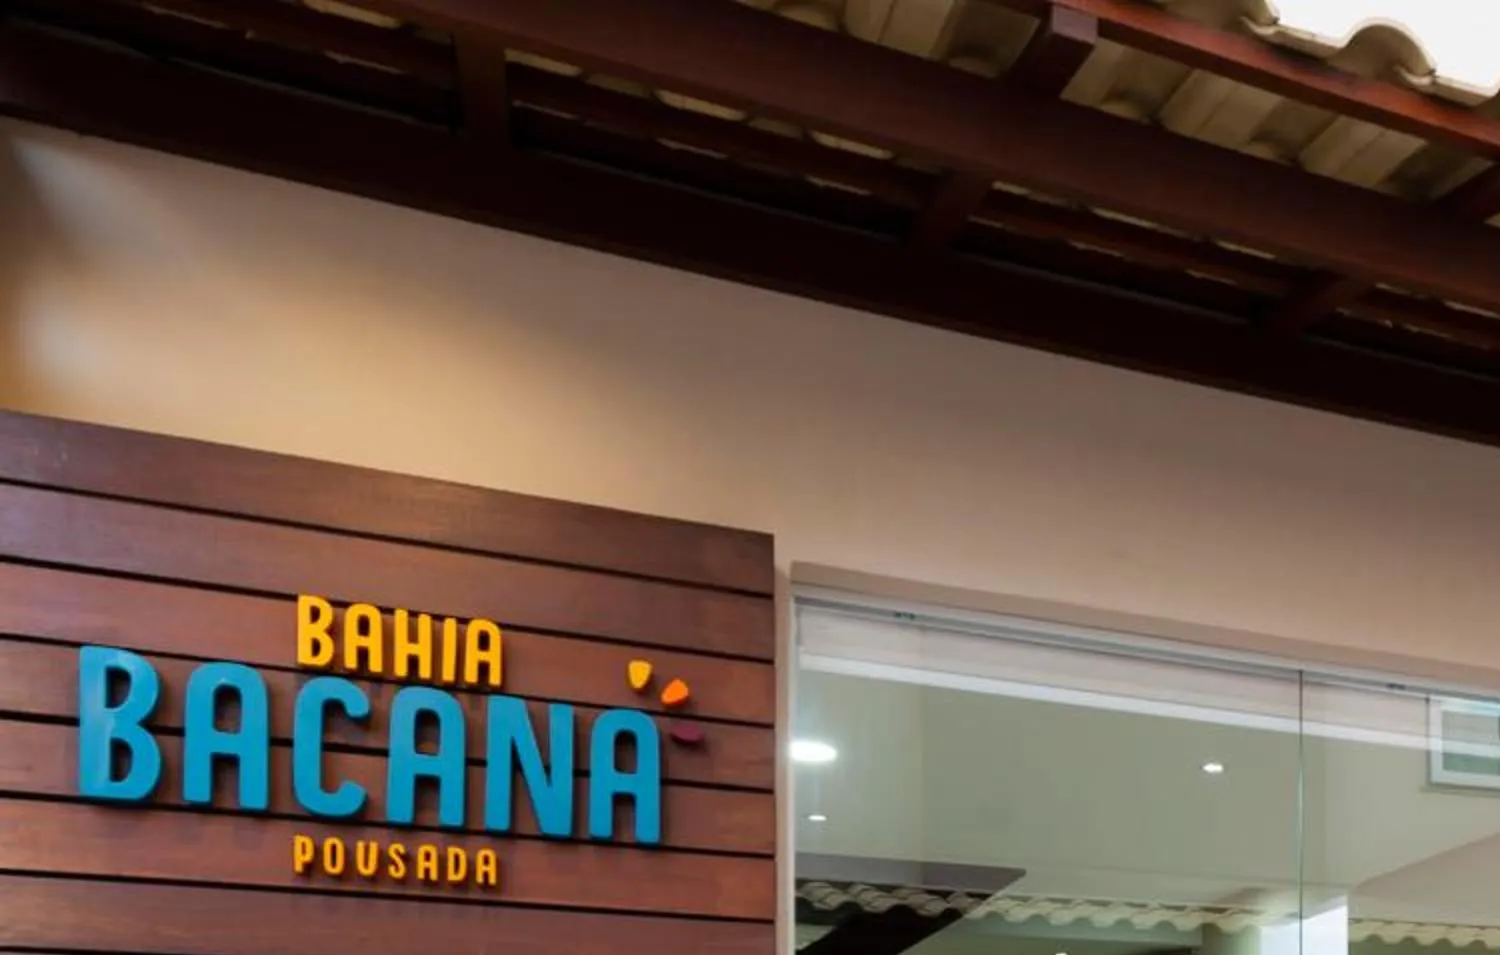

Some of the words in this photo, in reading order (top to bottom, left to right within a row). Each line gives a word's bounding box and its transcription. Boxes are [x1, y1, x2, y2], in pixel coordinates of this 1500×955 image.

[296, 594, 503, 686] BAHIA
[78, 644, 661, 844] BACANA
[293, 835, 499, 886] POUSADA
